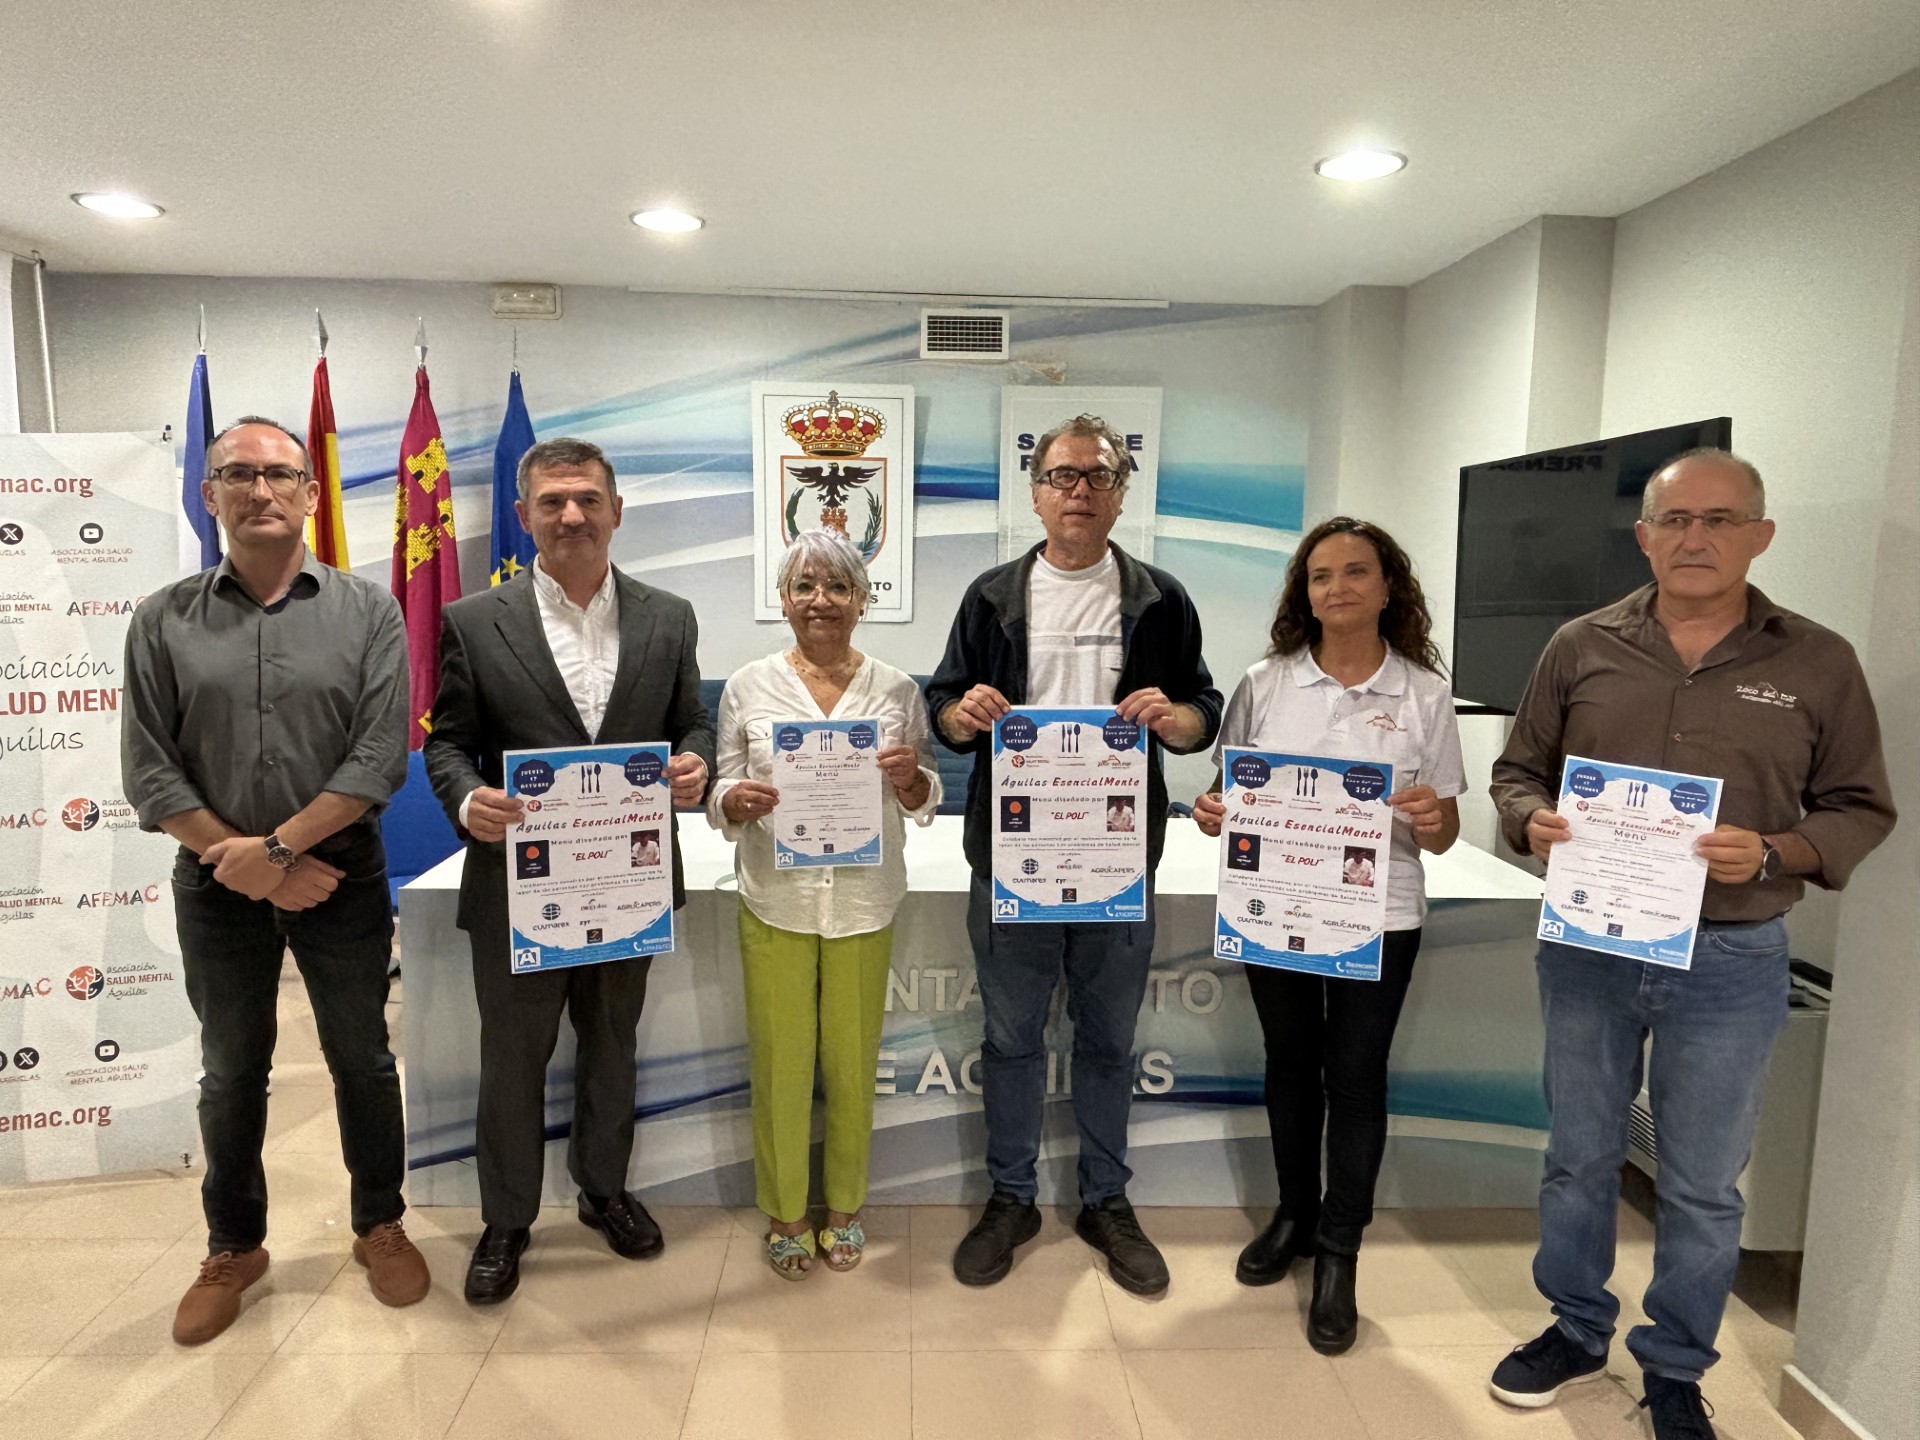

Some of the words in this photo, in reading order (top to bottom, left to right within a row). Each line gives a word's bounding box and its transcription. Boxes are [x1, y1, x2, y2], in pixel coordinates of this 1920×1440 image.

[107, 548, 133, 556] SALUD
[14, 603, 52, 612] MENTAL
[67, 596, 148, 617] AFEMA
[58, 688, 123, 713] MEN
[1001, 776, 1048, 788] Águilas
[1052, 777, 1140, 788] EsencialMente
[102, 808, 130, 818] SALUD
[1230, 811, 1280, 828] Águilas
[1284, 819, 1383, 840] EsencialMente
[1614, 830, 1648, 841] Menú
[25, 896, 64, 906] MENTAL
[77, 884, 158, 909] AFEMAC
[107, 962, 158, 974] asociación
[107, 976, 136, 986] SALUD
[138, 972, 174, 984] MENTAL
